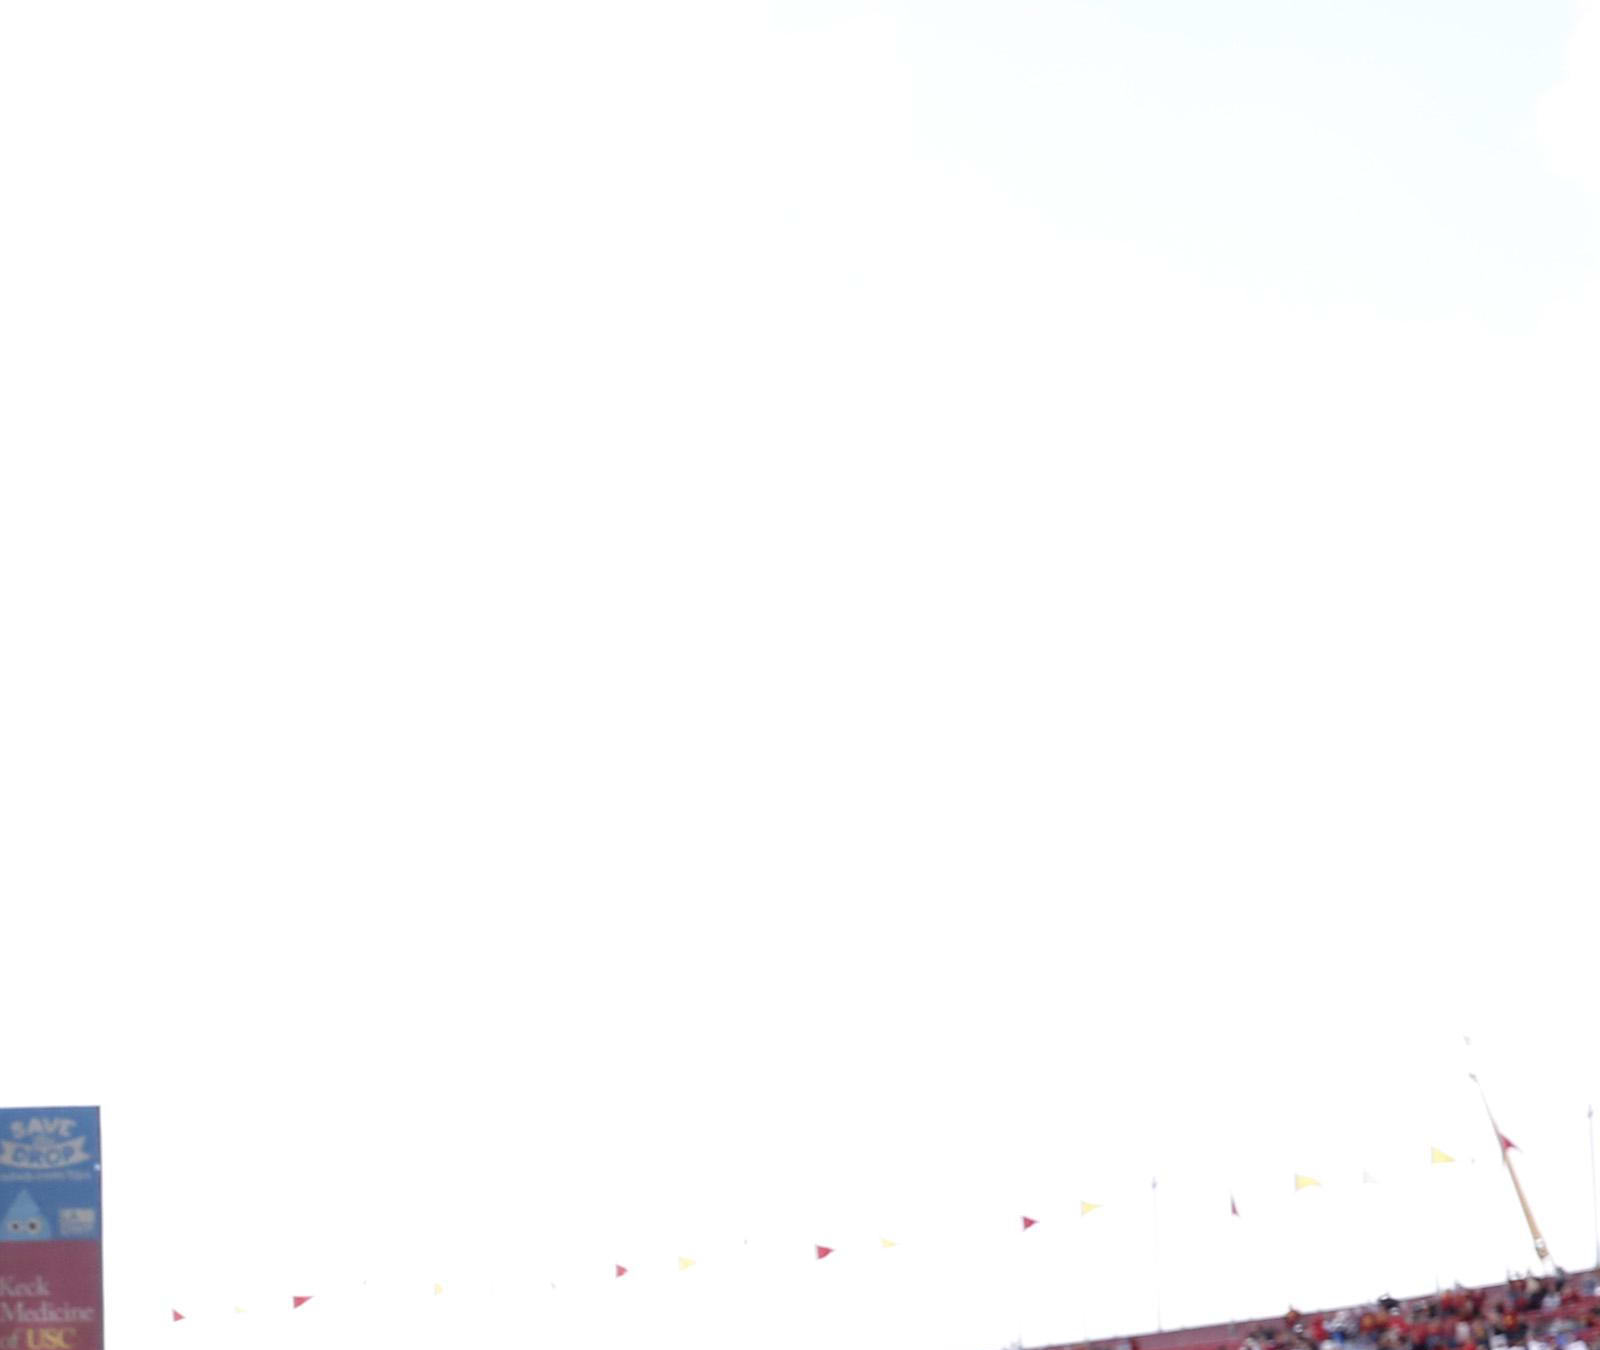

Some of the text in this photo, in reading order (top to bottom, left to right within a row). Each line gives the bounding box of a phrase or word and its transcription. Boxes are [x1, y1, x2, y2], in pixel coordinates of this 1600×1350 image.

[0, 1275, 50, 1297] Keck
[0, 1301, 95, 1322] Medicine
[26, 1327, 77, 1350] USC
